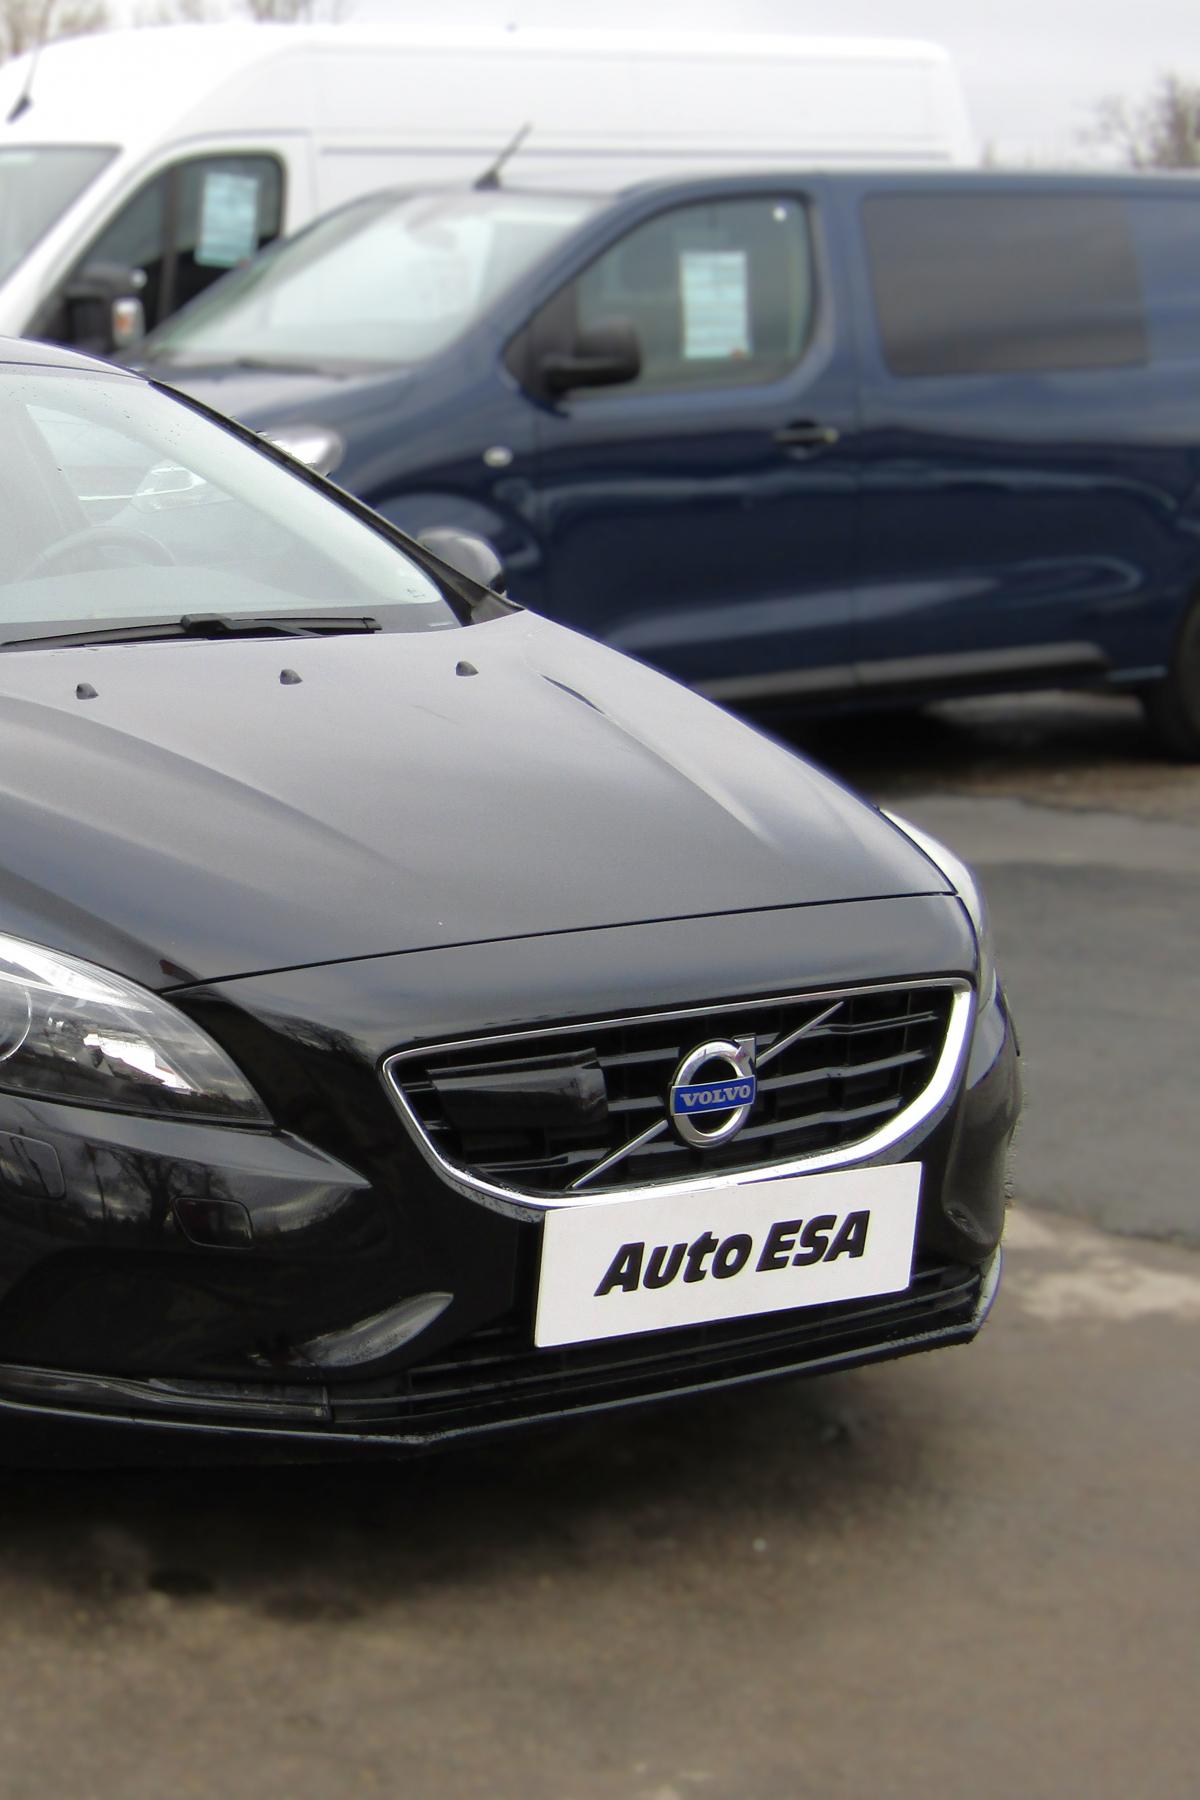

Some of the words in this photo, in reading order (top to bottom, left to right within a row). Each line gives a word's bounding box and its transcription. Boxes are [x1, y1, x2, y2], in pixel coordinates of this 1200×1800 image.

[680, 1084, 752, 1107] VOLVO
[593, 1231, 753, 1297] Auto
[755, 1209, 871, 1273] ESA
